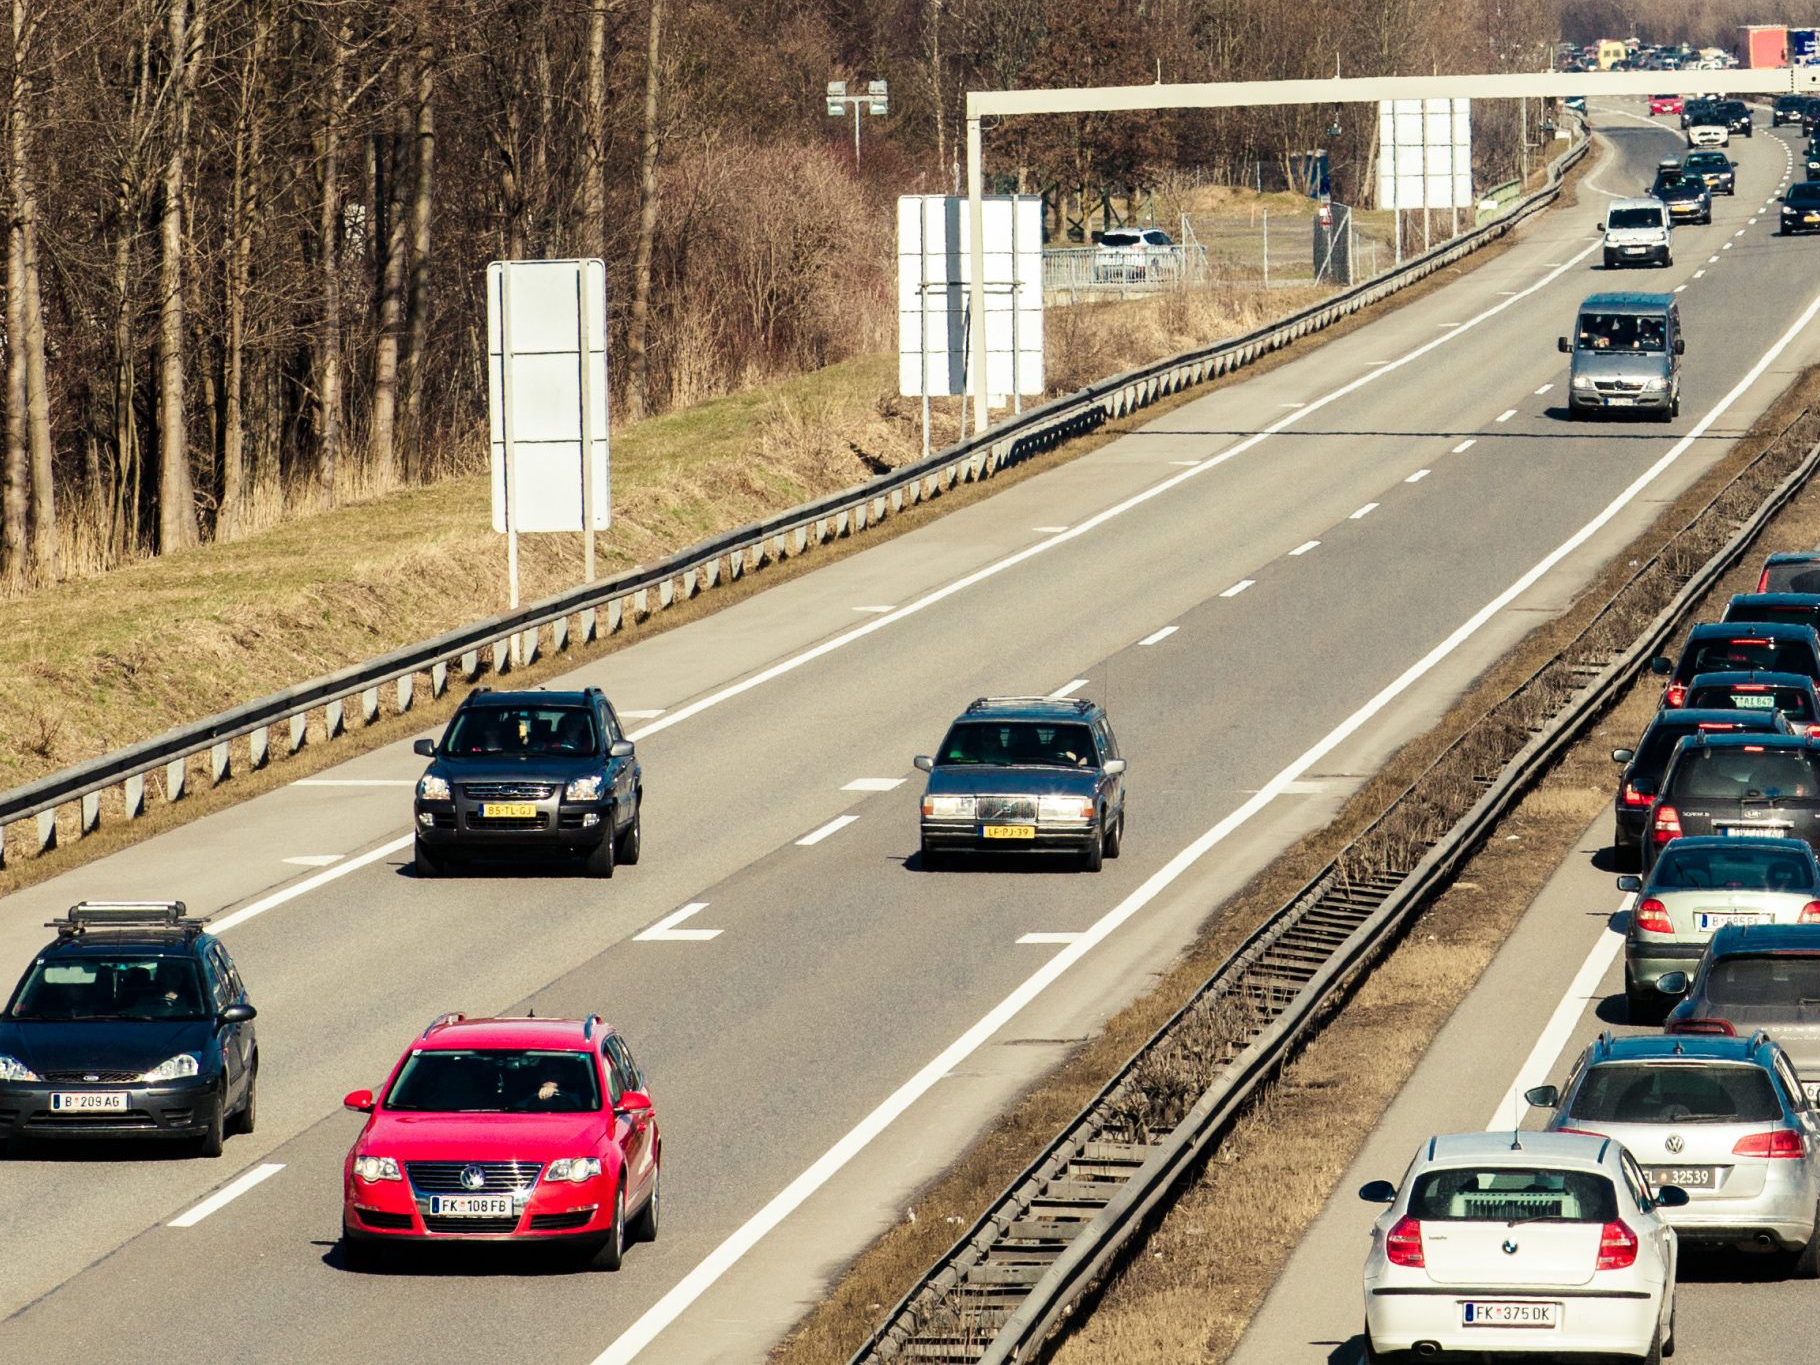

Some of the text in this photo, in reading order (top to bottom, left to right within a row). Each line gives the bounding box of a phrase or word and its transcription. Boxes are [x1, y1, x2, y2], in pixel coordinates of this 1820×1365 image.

[65, 1096, 120, 1107] B 209 AG
[1671, 1170, 1709, 1184] 32539
[442, 1199, 507, 1212] FK 108 FB
[1476, 1306, 1550, 1321] FK 375 DK
